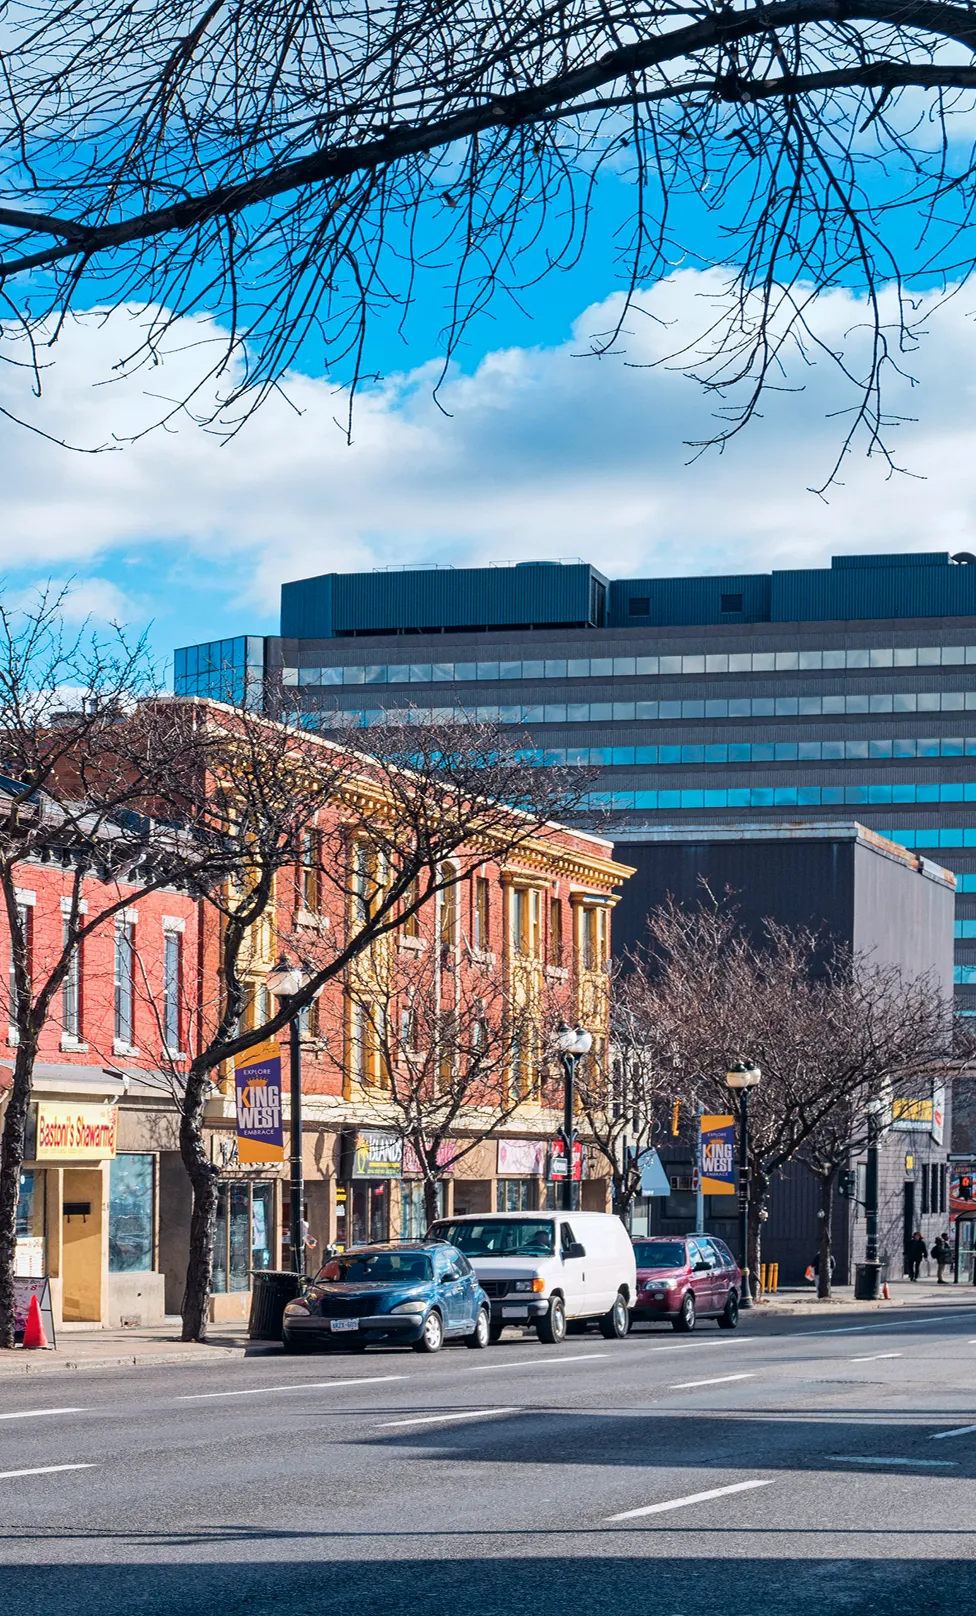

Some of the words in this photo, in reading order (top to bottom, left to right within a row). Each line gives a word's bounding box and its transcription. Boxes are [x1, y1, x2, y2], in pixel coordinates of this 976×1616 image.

[236, 1086, 279, 1107] KING
[237, 1106, 281, 1128] WEST
[76, 1115, 114, 1148] Shawarma
[702, 1143, 733, 1158] KING
[702, 1157, 733, 1172] WEST
